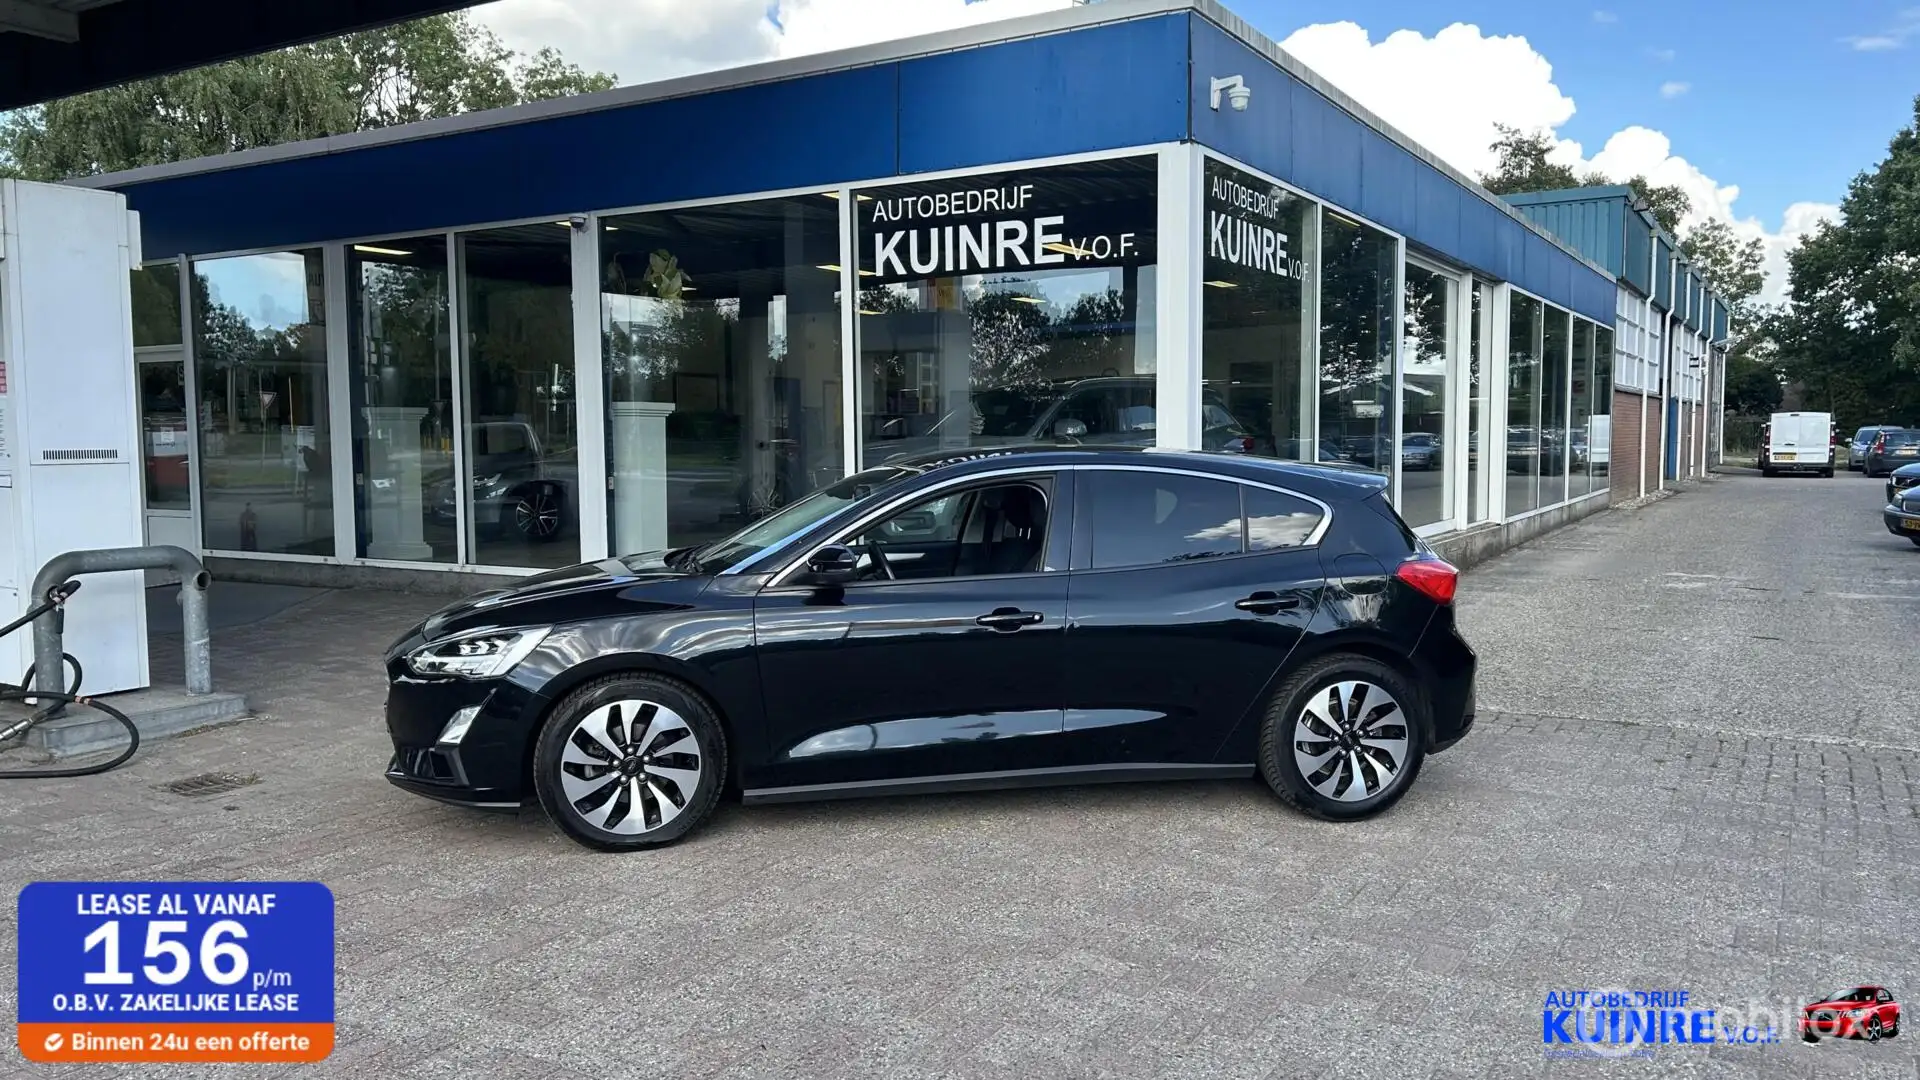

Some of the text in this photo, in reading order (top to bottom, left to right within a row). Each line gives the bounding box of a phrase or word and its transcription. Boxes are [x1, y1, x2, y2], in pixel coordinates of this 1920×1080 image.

[873, 184, 1033, 223] AUTOBEDRIJF
[1211, 176, 1280, 219] AUTOBEDRIJF
[875, 215, 1139, 276] KUINRE V.O.F.
[1210, 211, 1288, 277] KUINRE
